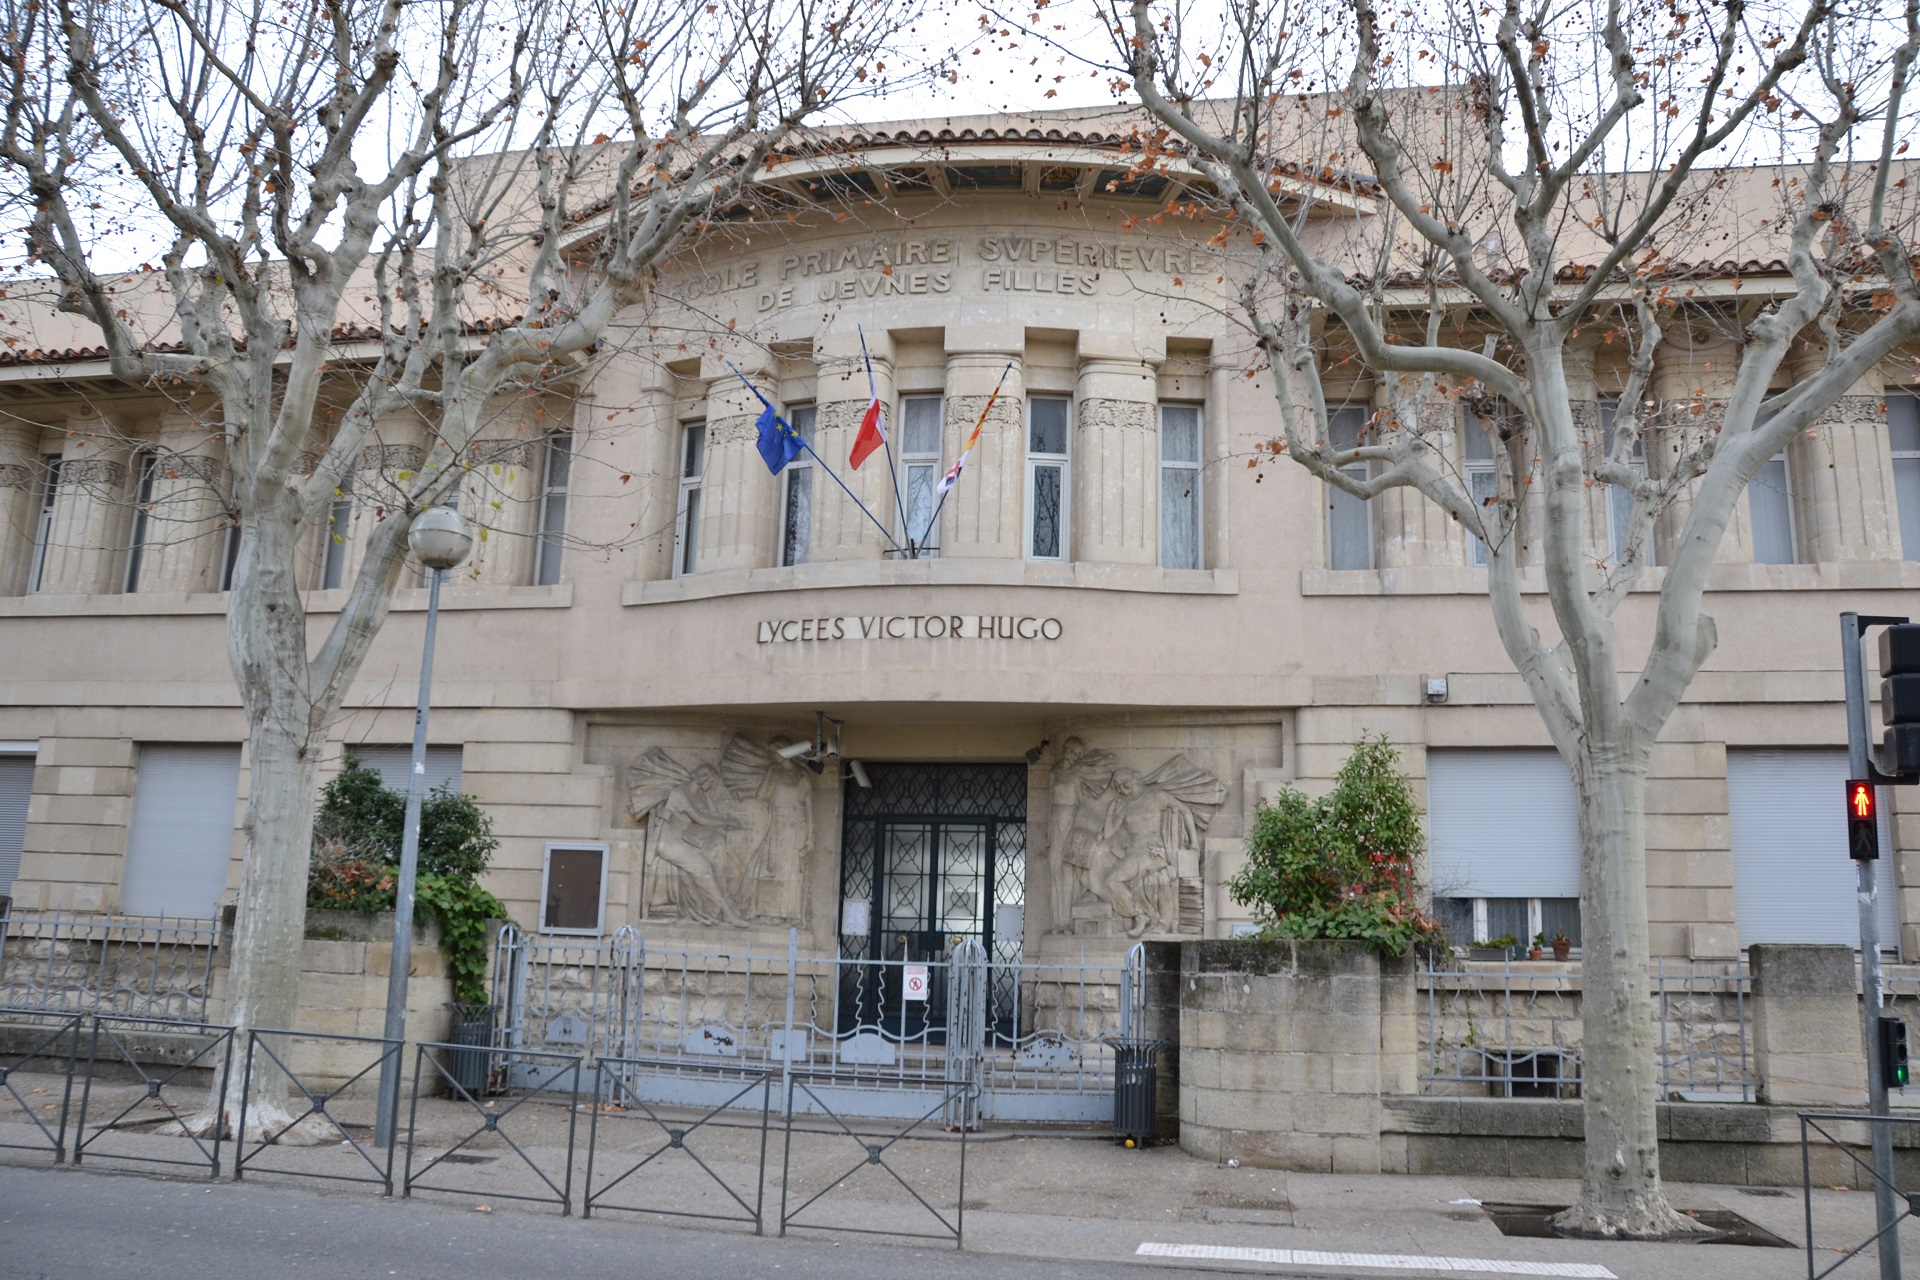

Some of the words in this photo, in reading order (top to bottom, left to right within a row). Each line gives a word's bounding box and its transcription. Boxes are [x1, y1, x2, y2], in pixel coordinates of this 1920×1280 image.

[780, 239, 950, 281] PRIMAIRE
[758, 287, 793, 312] DE
[984, 269, 1098, 296] FILLES
[757, 617, 845, 644] LYCEES
[858, 616, 964, 639] VICTOR
[978, 616, 1063, 641] HUGO
